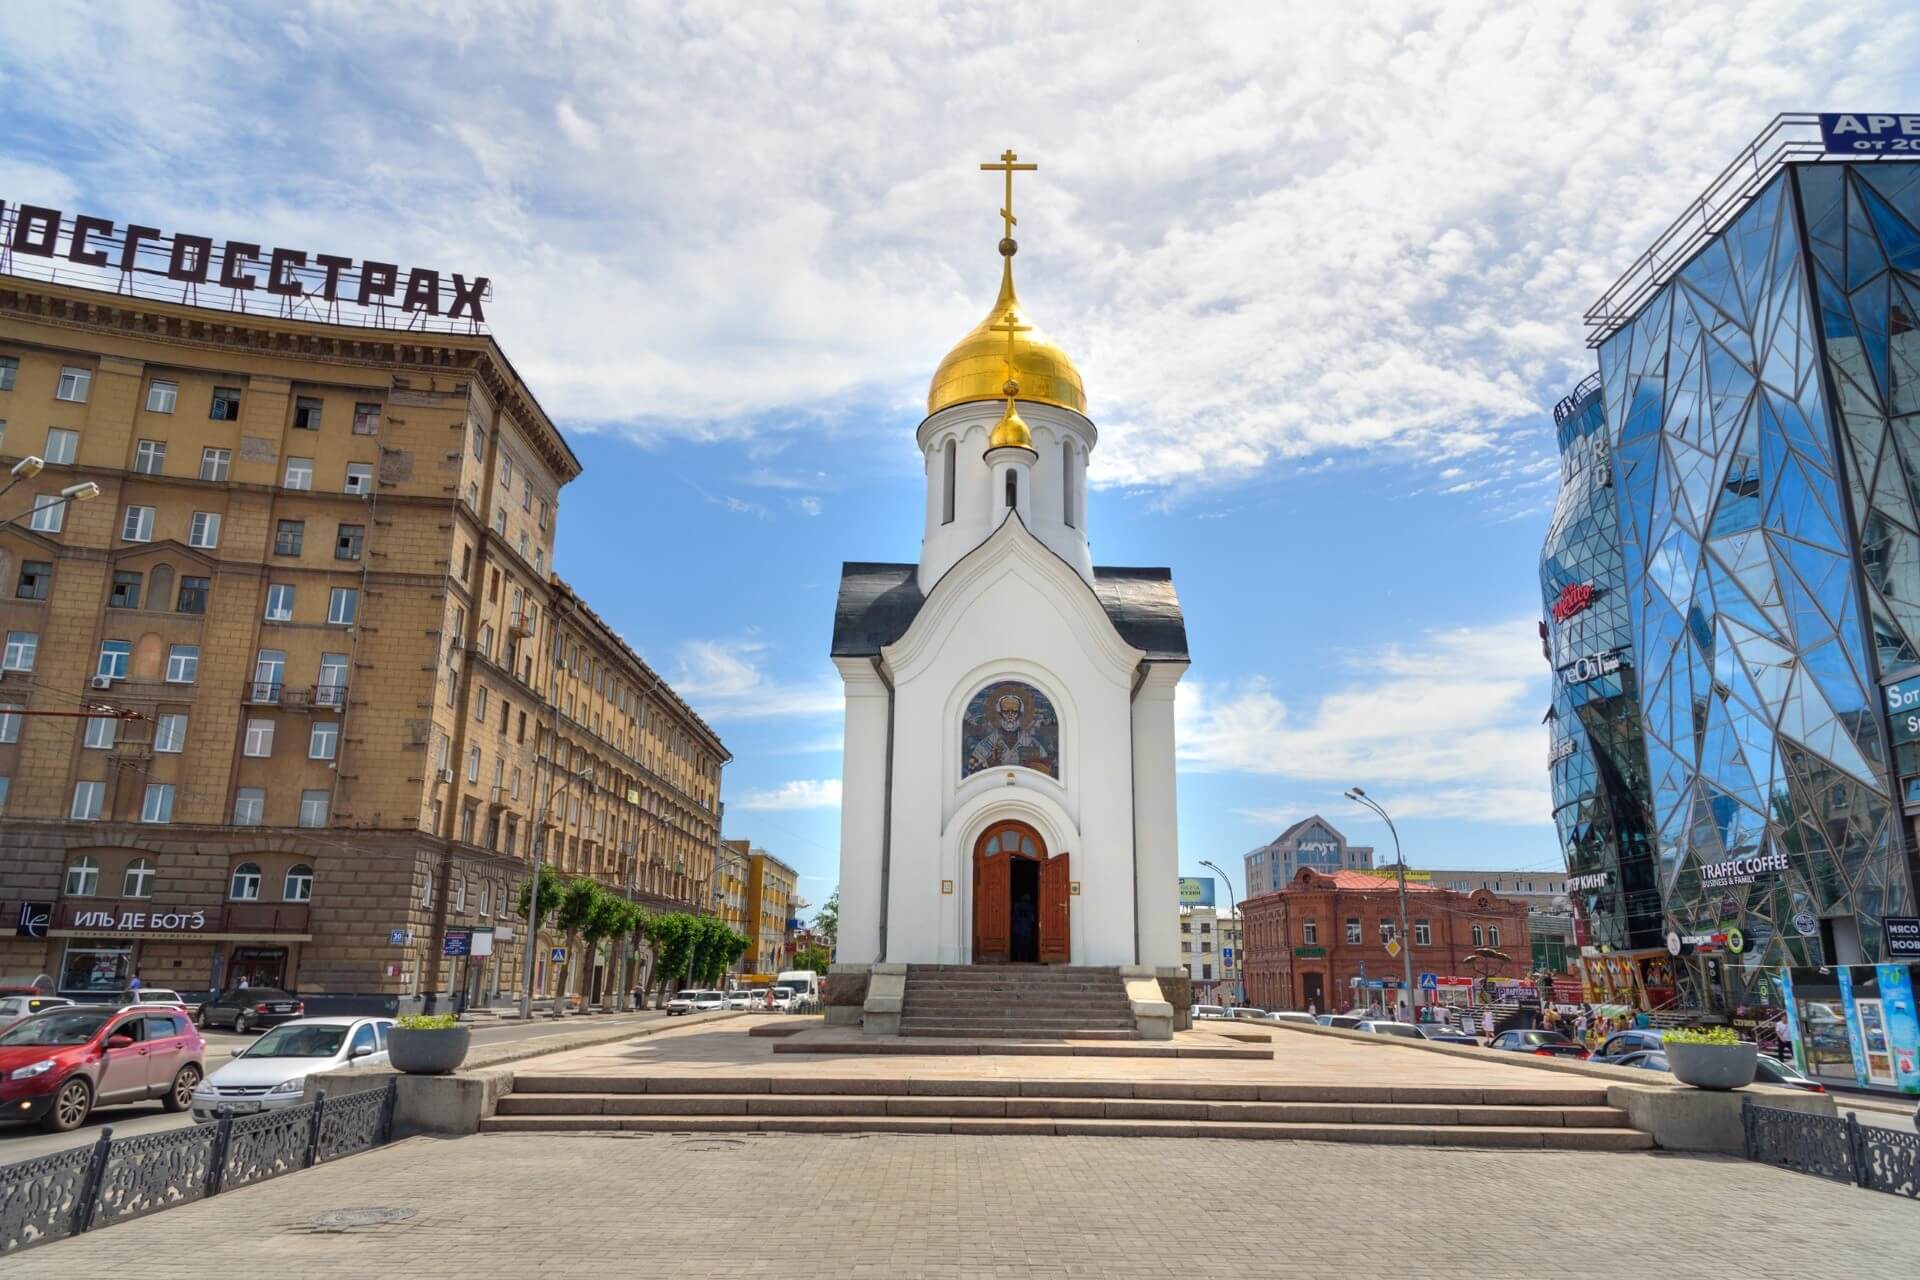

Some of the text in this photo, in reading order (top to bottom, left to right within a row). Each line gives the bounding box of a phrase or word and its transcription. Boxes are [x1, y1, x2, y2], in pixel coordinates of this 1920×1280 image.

[0, 199, 488, 322] ОСГОССТРАХ
[1700, 854, 1789, 880] TRAFFIC COFFEE
[1581, 872, 1608, 890] КИНГ
[1702, 877, 1728, 888] BUSINESS
[1736, 874, 1756, 885] FAMILY
[74, 911, 115, 927] ИЛЬ
[117, 912, 146, 930] ДЕ
